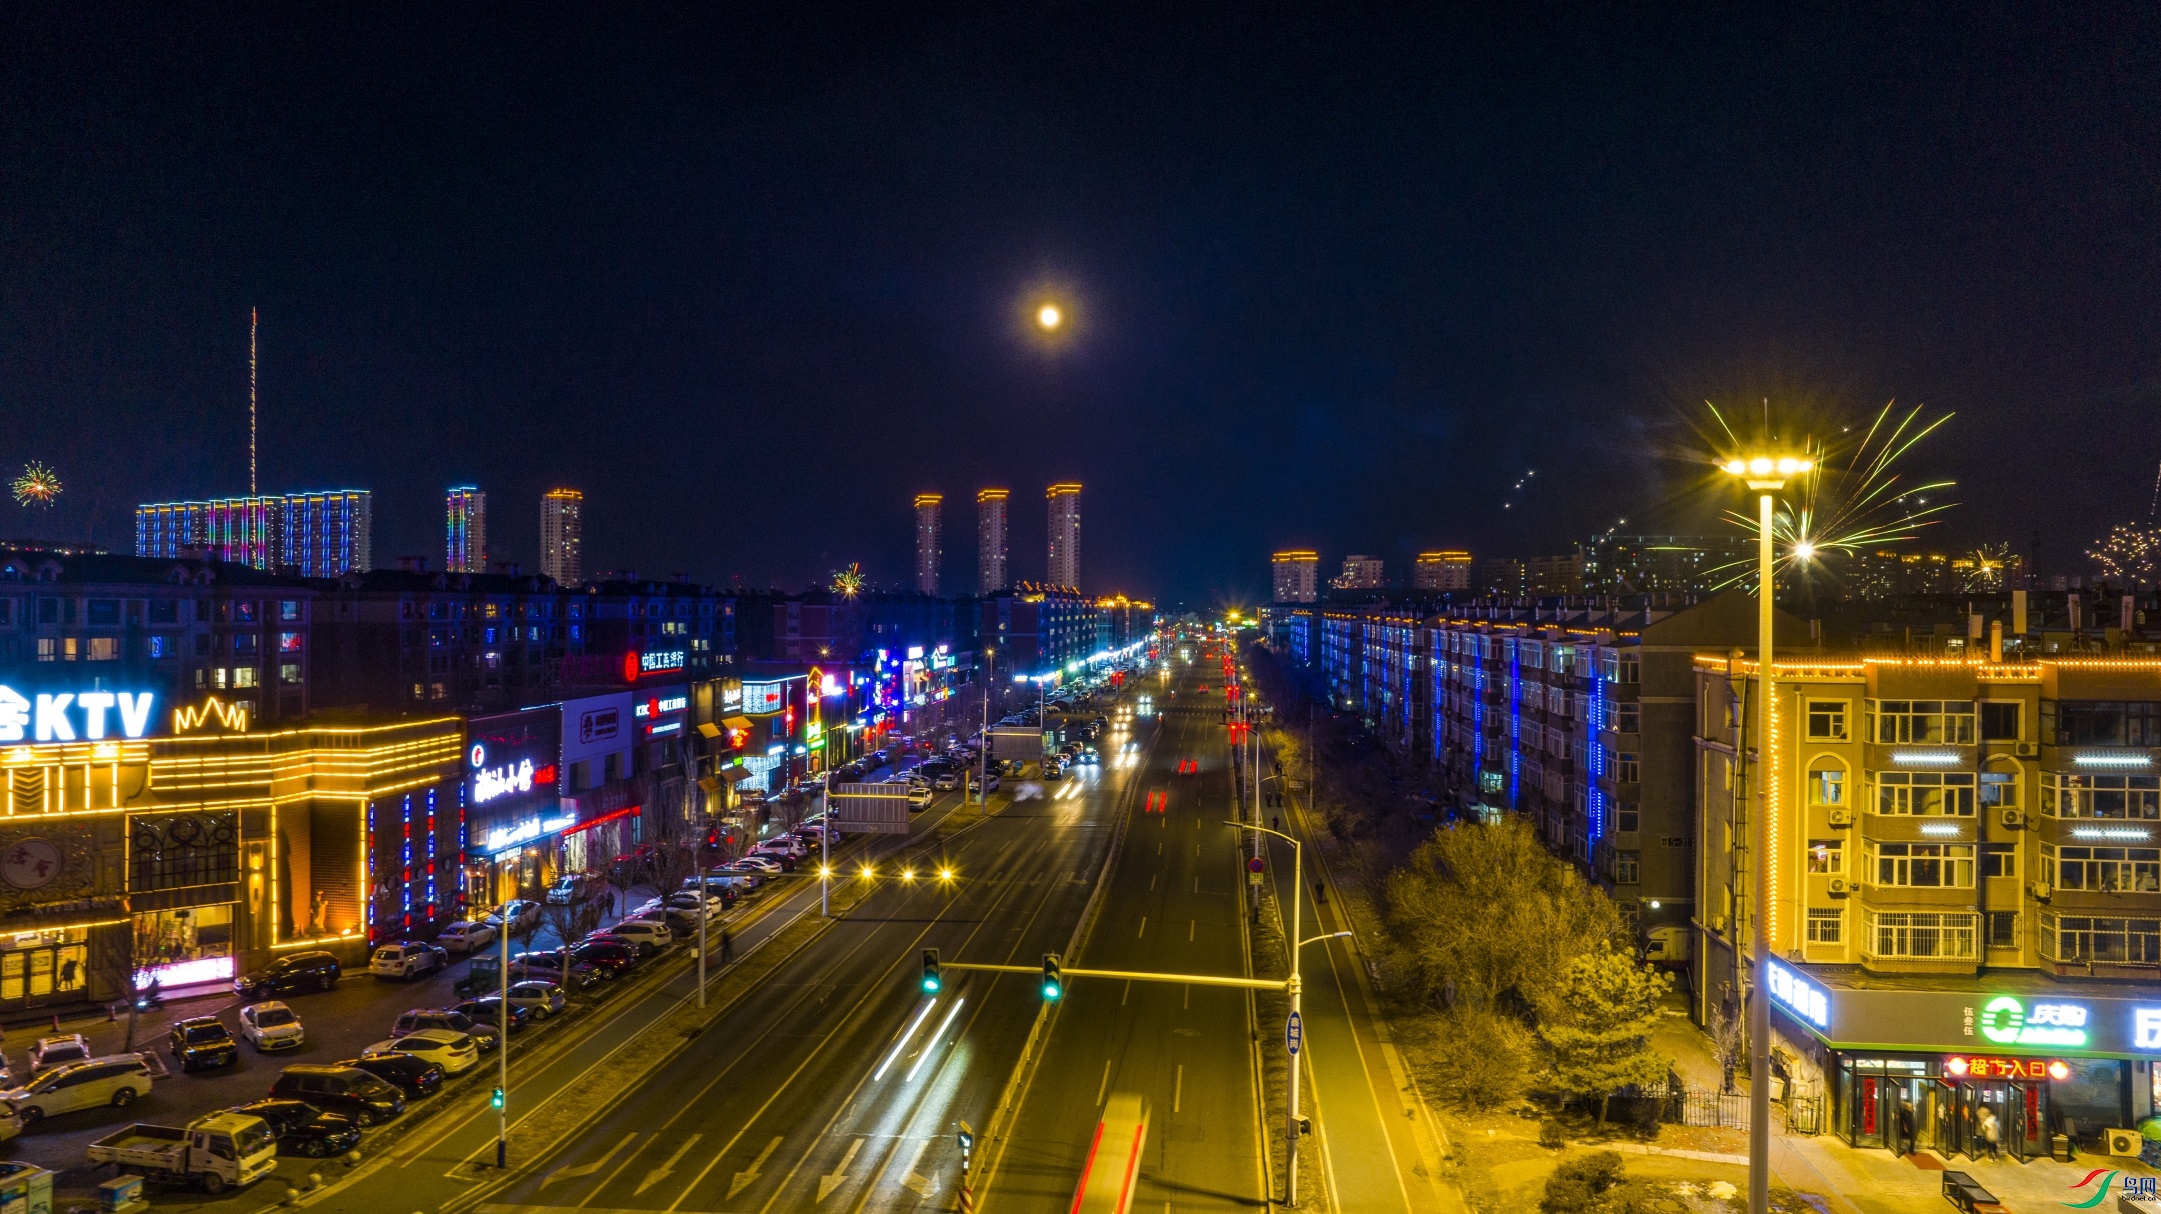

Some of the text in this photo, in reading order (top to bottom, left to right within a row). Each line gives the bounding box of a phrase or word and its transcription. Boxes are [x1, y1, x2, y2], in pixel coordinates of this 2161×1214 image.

[641, 651, 684, 671] 中国工商银行
[1969, 1058, 2046, 1078] 超市入口
